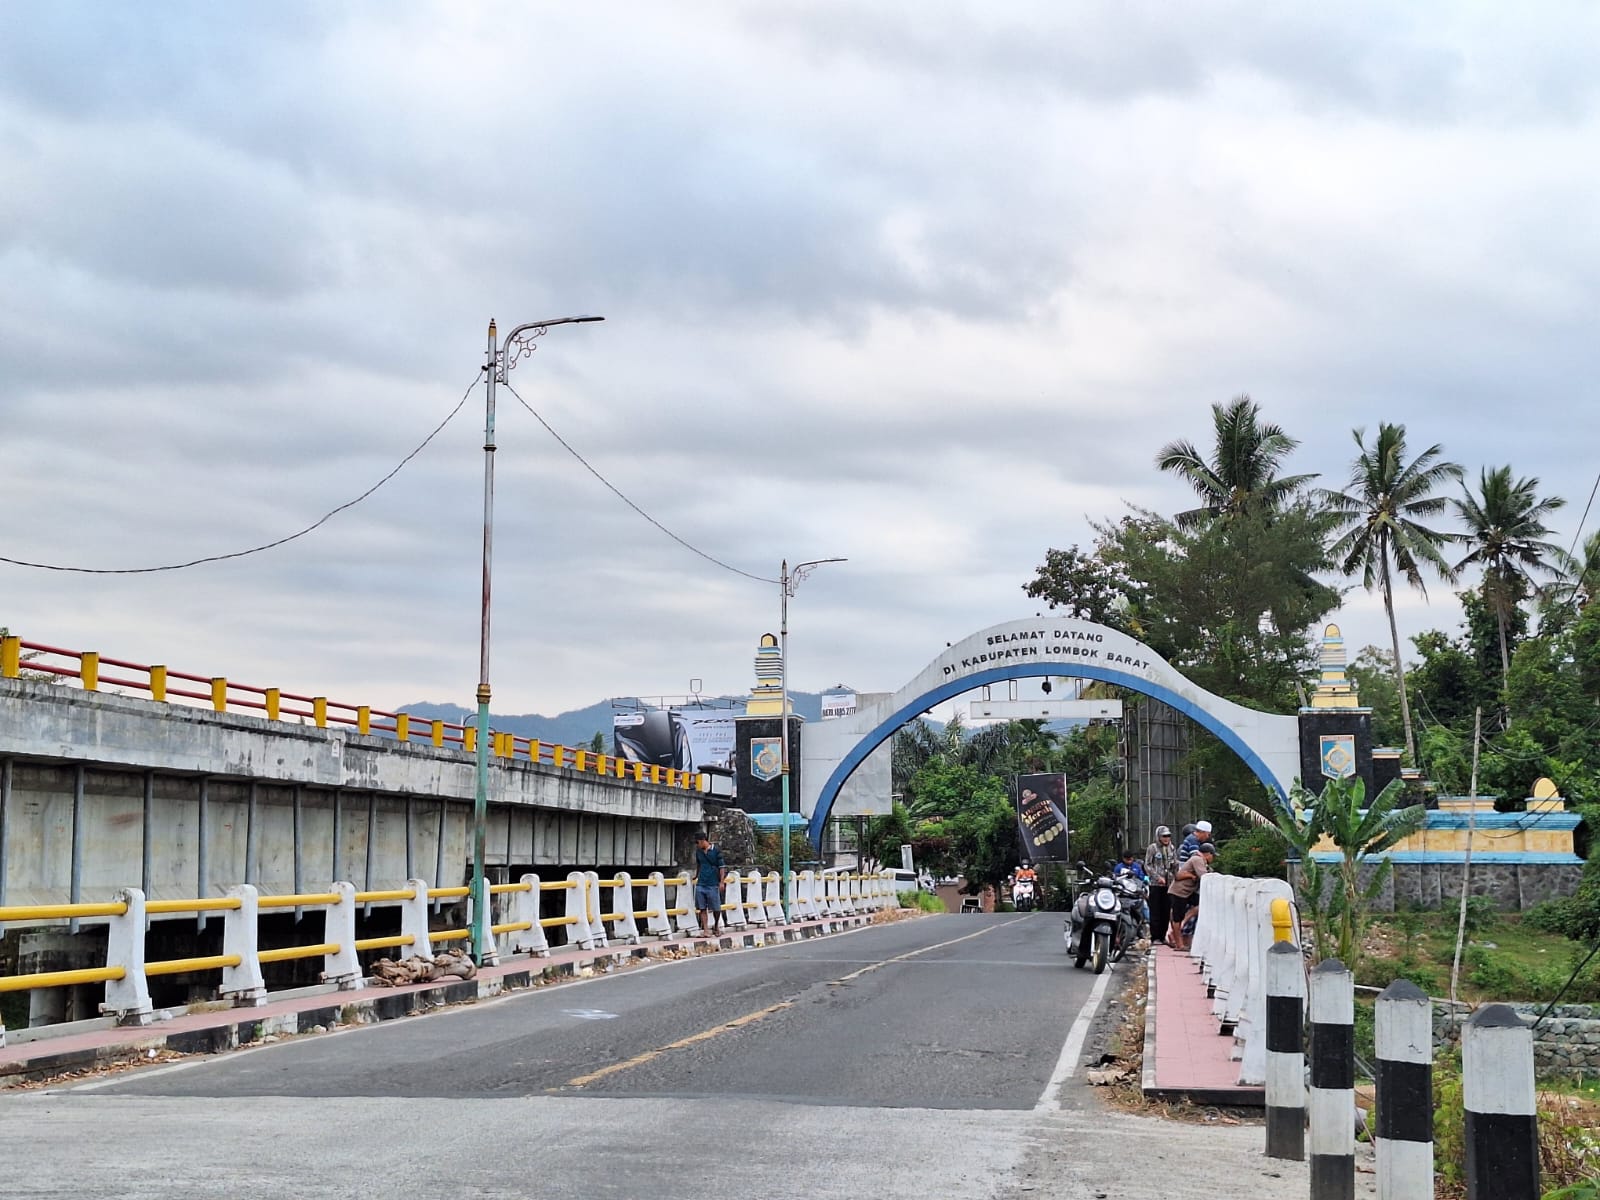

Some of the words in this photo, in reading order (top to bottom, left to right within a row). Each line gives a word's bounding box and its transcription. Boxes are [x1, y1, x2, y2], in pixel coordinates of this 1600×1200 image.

[987, 630, 1045, 645] SELAMAT
[1054, 630, 1103, 642] DATANG
[943, 664, 956, 675] DI
[961, 646, 1037, 668] KABUPATEN
[1045, 646, 1098, 658] LOMBOK
[1107, 652, 1150, 670] BARAT
[1024, 805, 1053, 824] Merah
